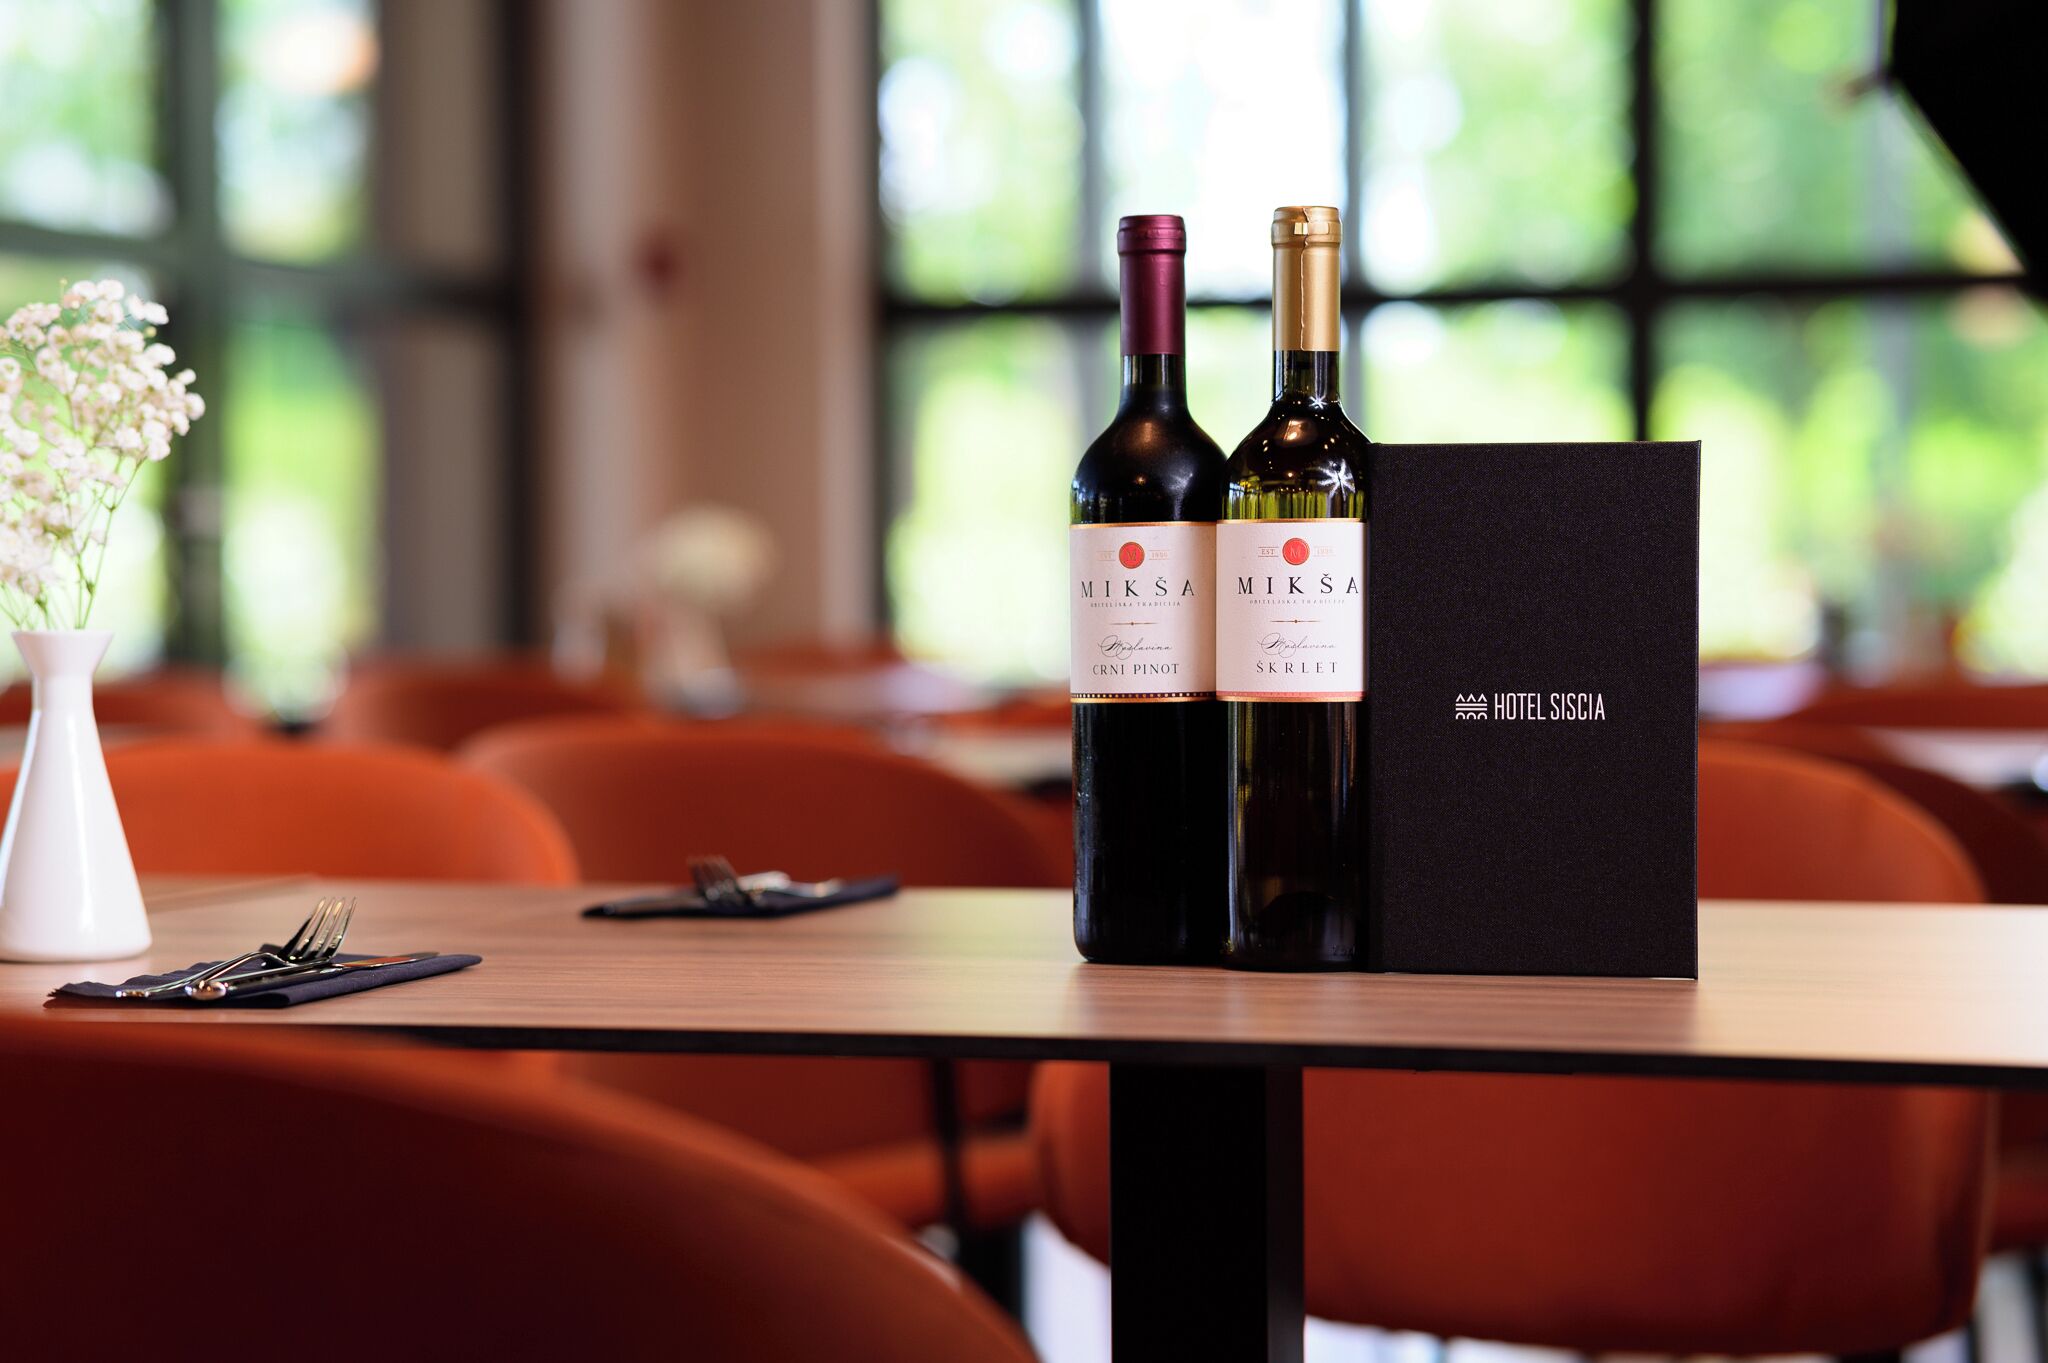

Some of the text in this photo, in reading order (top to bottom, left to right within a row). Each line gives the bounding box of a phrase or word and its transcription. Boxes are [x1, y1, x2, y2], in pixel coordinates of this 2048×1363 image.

[1081, 577, 1195, 599] MIKŠA
[1238, 573, 1359, 595] MIKŠA
[1097, 634, 1172, 660] Moslavina
[1257, 632, 1336, 659] Moslavina
[1092, 663, 1180, 675] CRNI PINOT
[1256, 660, 1338, 673] ŠKRLET
[1494, 693, 1606, 720] HOTEL SISCIA
